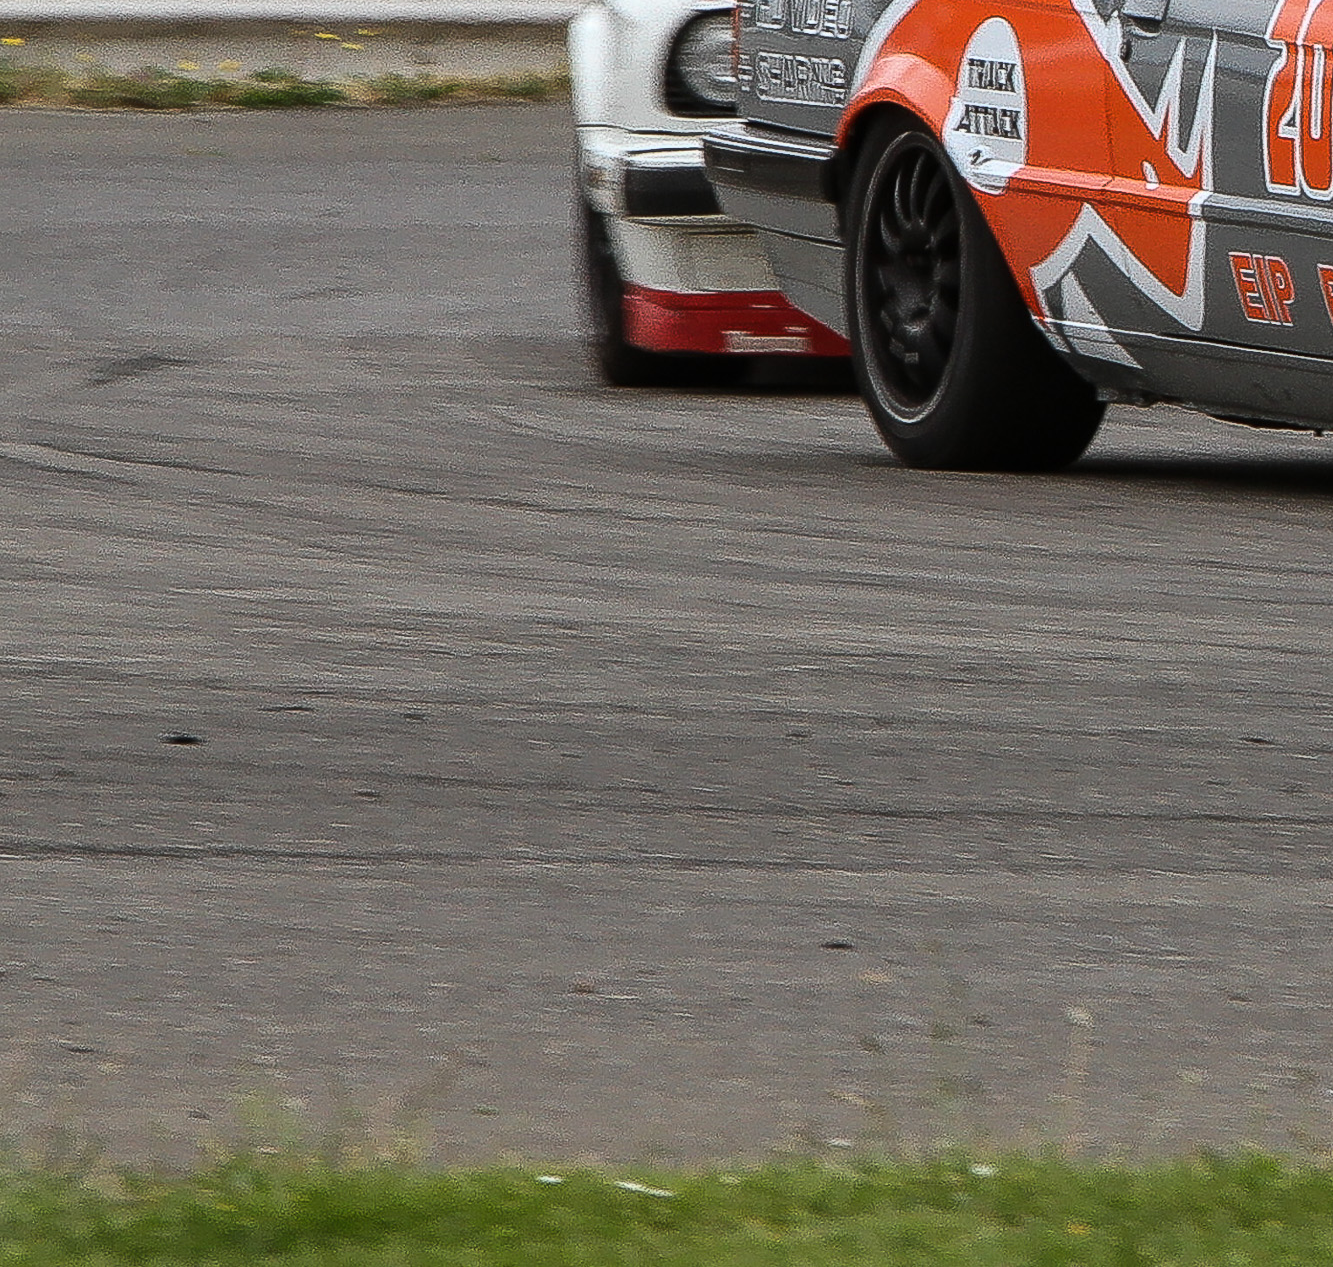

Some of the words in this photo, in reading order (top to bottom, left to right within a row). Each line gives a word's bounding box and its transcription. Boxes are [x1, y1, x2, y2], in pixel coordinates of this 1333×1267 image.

[968, 58, 1017, 94] TRACK
[953, 104, 1022, 140] ATTACK
[1228, 251, 1295, 326] EIP
